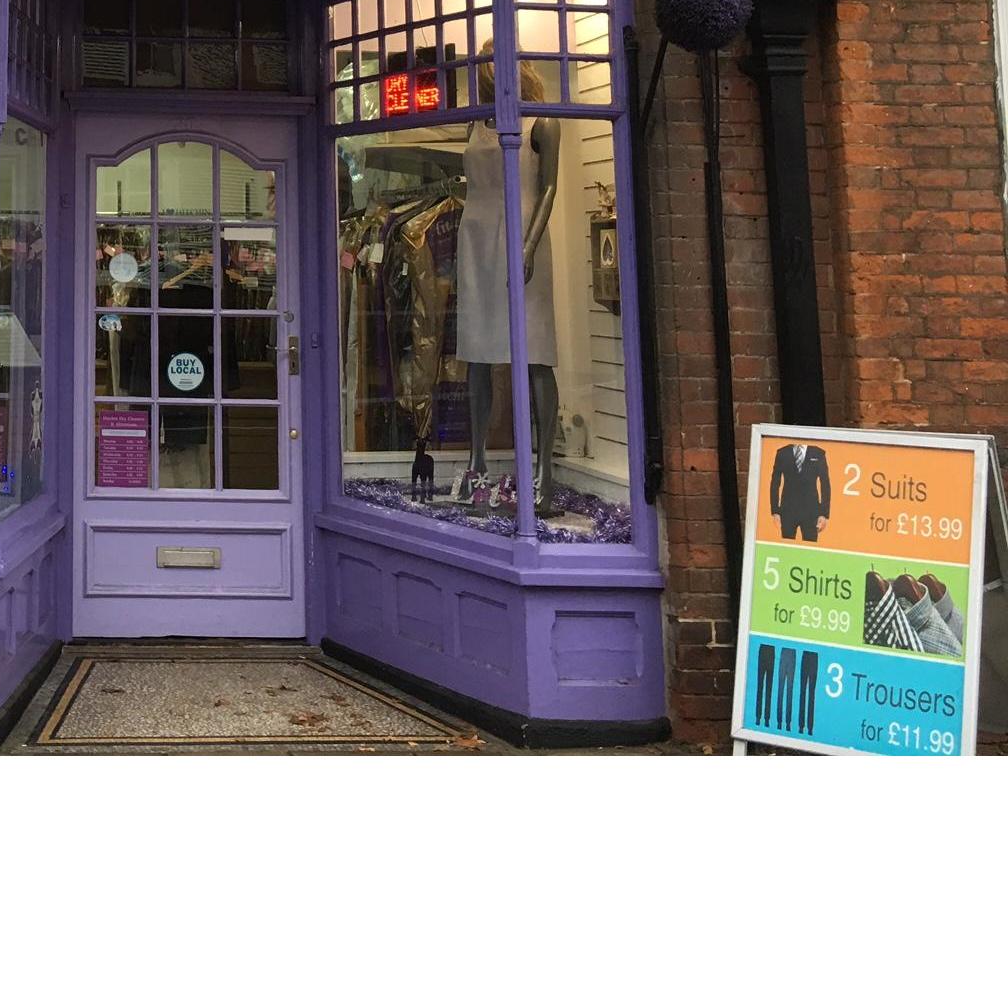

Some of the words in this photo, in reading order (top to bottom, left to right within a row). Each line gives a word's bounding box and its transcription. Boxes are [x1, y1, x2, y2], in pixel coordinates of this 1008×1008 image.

[386, 87, 440, 111] CLENER
[170, 366, 202, 375] LOCAL
[175, 358, 196, 367] BUY
[842, 463, 862, 497] 2
[869, 472, 928, 504] Suits
[869, 512, 892, 533] for
[896, 513, 963, 541] £13.99
[762, 557, 781, 591] 5
[788, 566, 853, 601] Shirts
[773, 603, 796, 625] for
[799, 604, 851, 633] £9.99
[824, 662, 844, 699] 3
[850, 672, 956, 717] Trousers
[860, 720, 883, 742] for
[887, 721, 955, 756] £11.99
